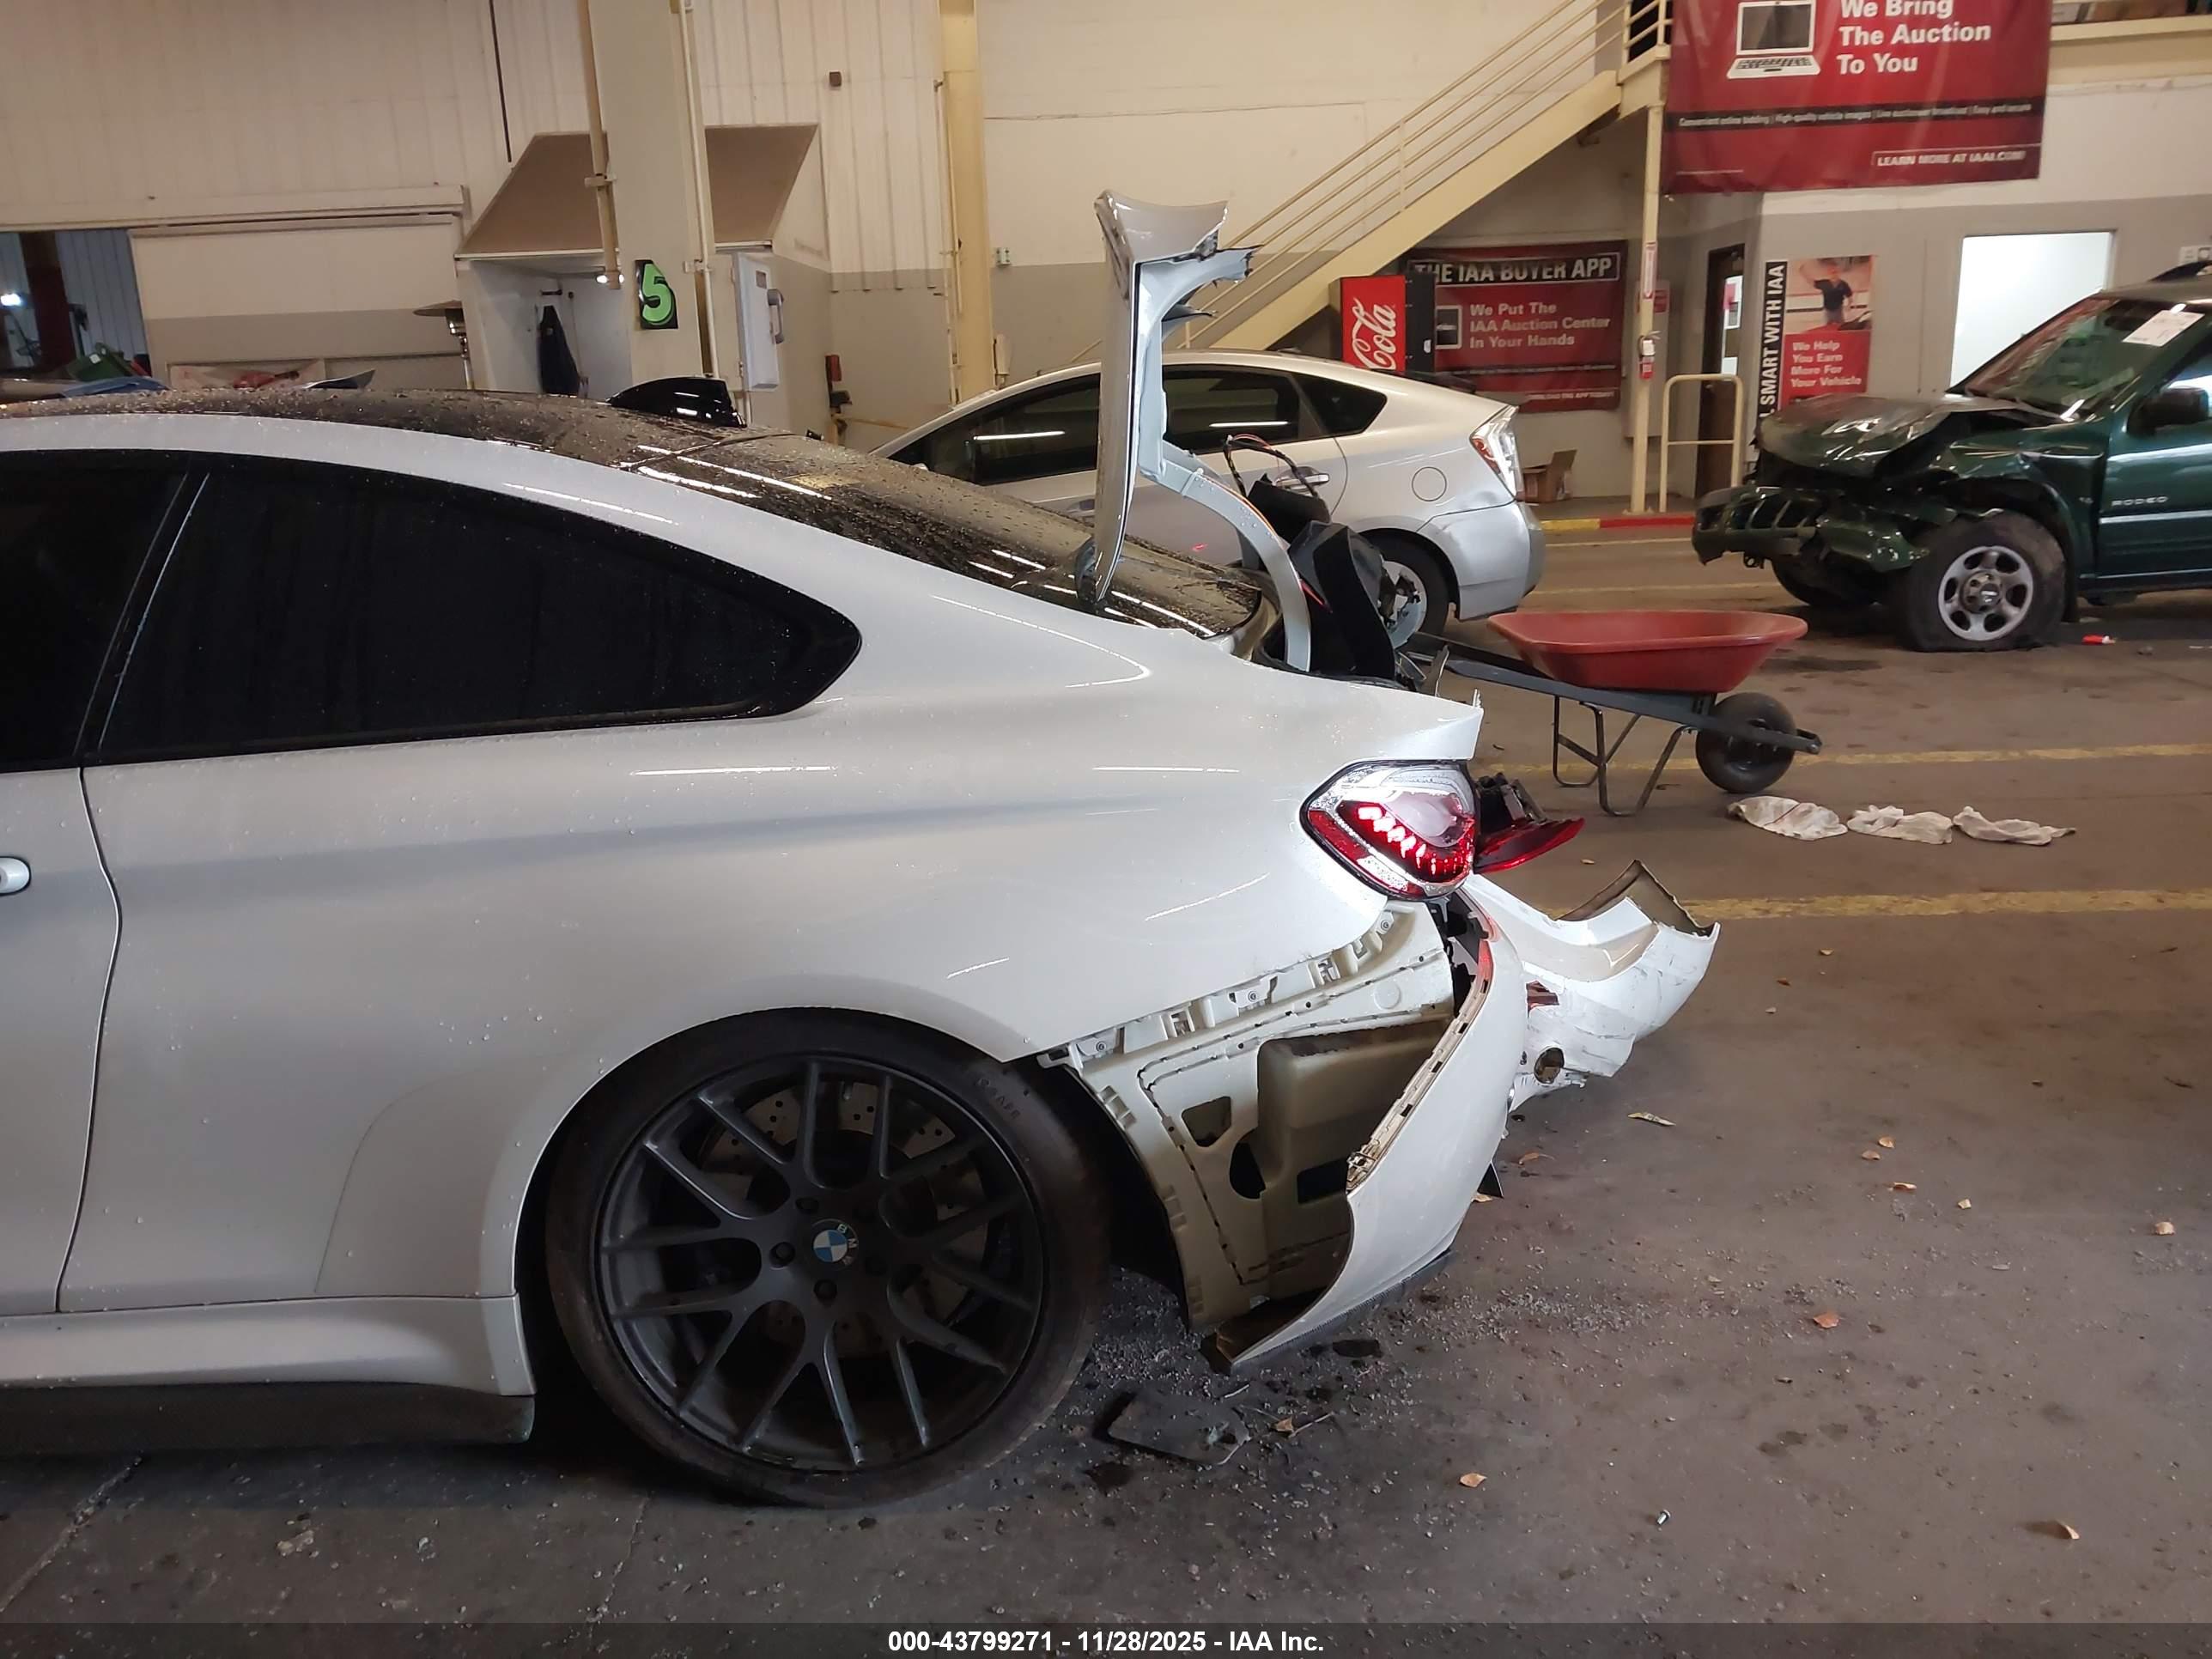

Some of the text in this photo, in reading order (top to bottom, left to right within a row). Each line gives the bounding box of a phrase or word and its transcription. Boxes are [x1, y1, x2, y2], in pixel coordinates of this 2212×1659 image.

[1841, 0, 1954, 19] We Bring
[1838, 21, 1991, 46] The Auction
[1837, 53, 1918, 75] To You
[1877, 155, 1916, 167] LEARN
[1918, 154, 1950, 164] MORE
[1952, 153, 1967, 163] AT
[1459, 263, 1495, 283] IAA
[1500, 260, 1566, 282] BUYER
[1571, 257, 1612, 278] APP
[1767, 264, 1785, 295] IAA
[641, 263, 673, 325] 5
[1469, 301, 1556, 317] We Put The
[1469, 316, 1611, 333] IAA Auction Center
[1764, 299, 1783, 344] WITH
[1469, 332, 1575, 349] In Your Hands
[1792, 340, 1840, 351] We Help
[1792, 352, 1843, 363] You Earn
[1759, 347, 1780, 406] SMART
[1790, 364, 1843, 375] More For
[1790, 375, 1862, 388] Your Vehicle
[2111, 495, 2169, 507] RODEO
